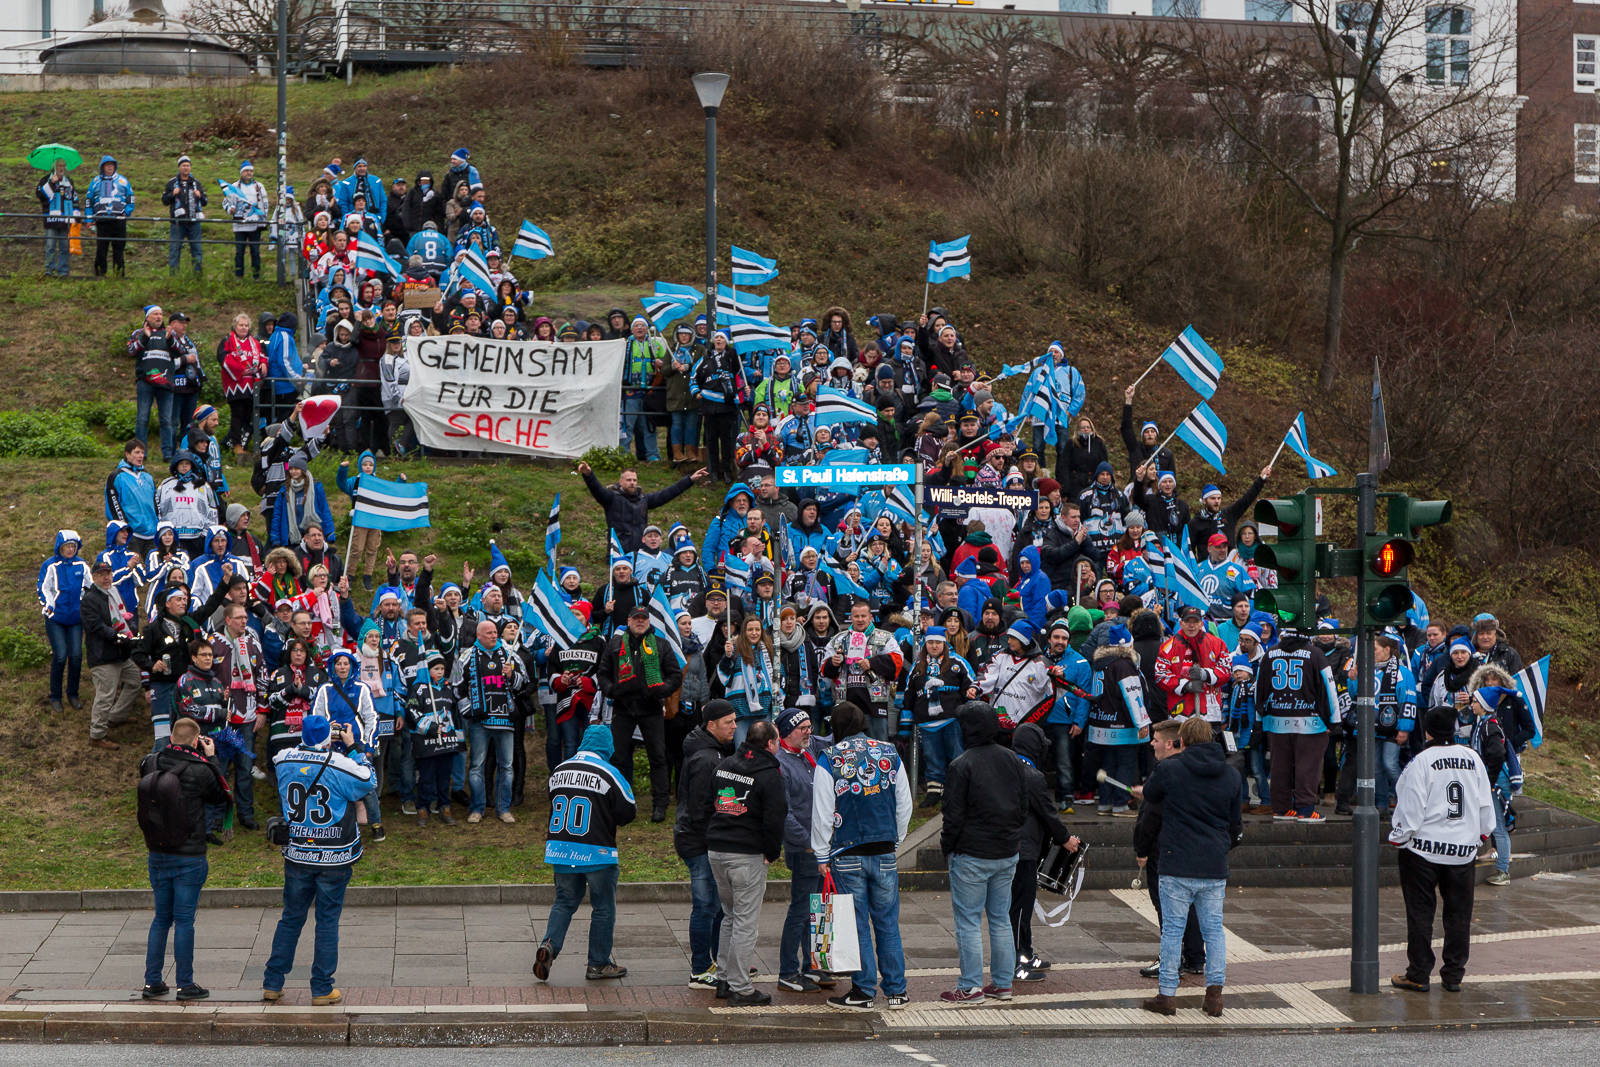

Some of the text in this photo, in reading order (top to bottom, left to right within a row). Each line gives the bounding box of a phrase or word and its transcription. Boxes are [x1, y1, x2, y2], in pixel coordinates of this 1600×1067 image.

[424, 240, 438, 260] 8
[417, 340, 593, 377] GEMEINSAM
[437, 381, 561, 413] FÜR DIE
[444, 413, 552, 448] SACHE
[782, 467, 909, 484] St. Pauli Hafenstraße
[930, 487, 1032, 509] Willi-Bartels-Treppe
[559, 650, 597, 663] HOLSTEN
[482, 675, 505, 688] mp
[1271, 659, 1304, 690] 35
[1098, 710, 1118, 722] Hotel
[1403, 703, 1417, 718] 50
[284, 751, 335, 765] IceFightes
[287, 781, 333, 826] 93
[1446, 781, 1465, 821] 9
[549, 794, 593, 837] 80
[321, 846, 353, 862] Hotel
[570, 850, 593, 862] Hotel
